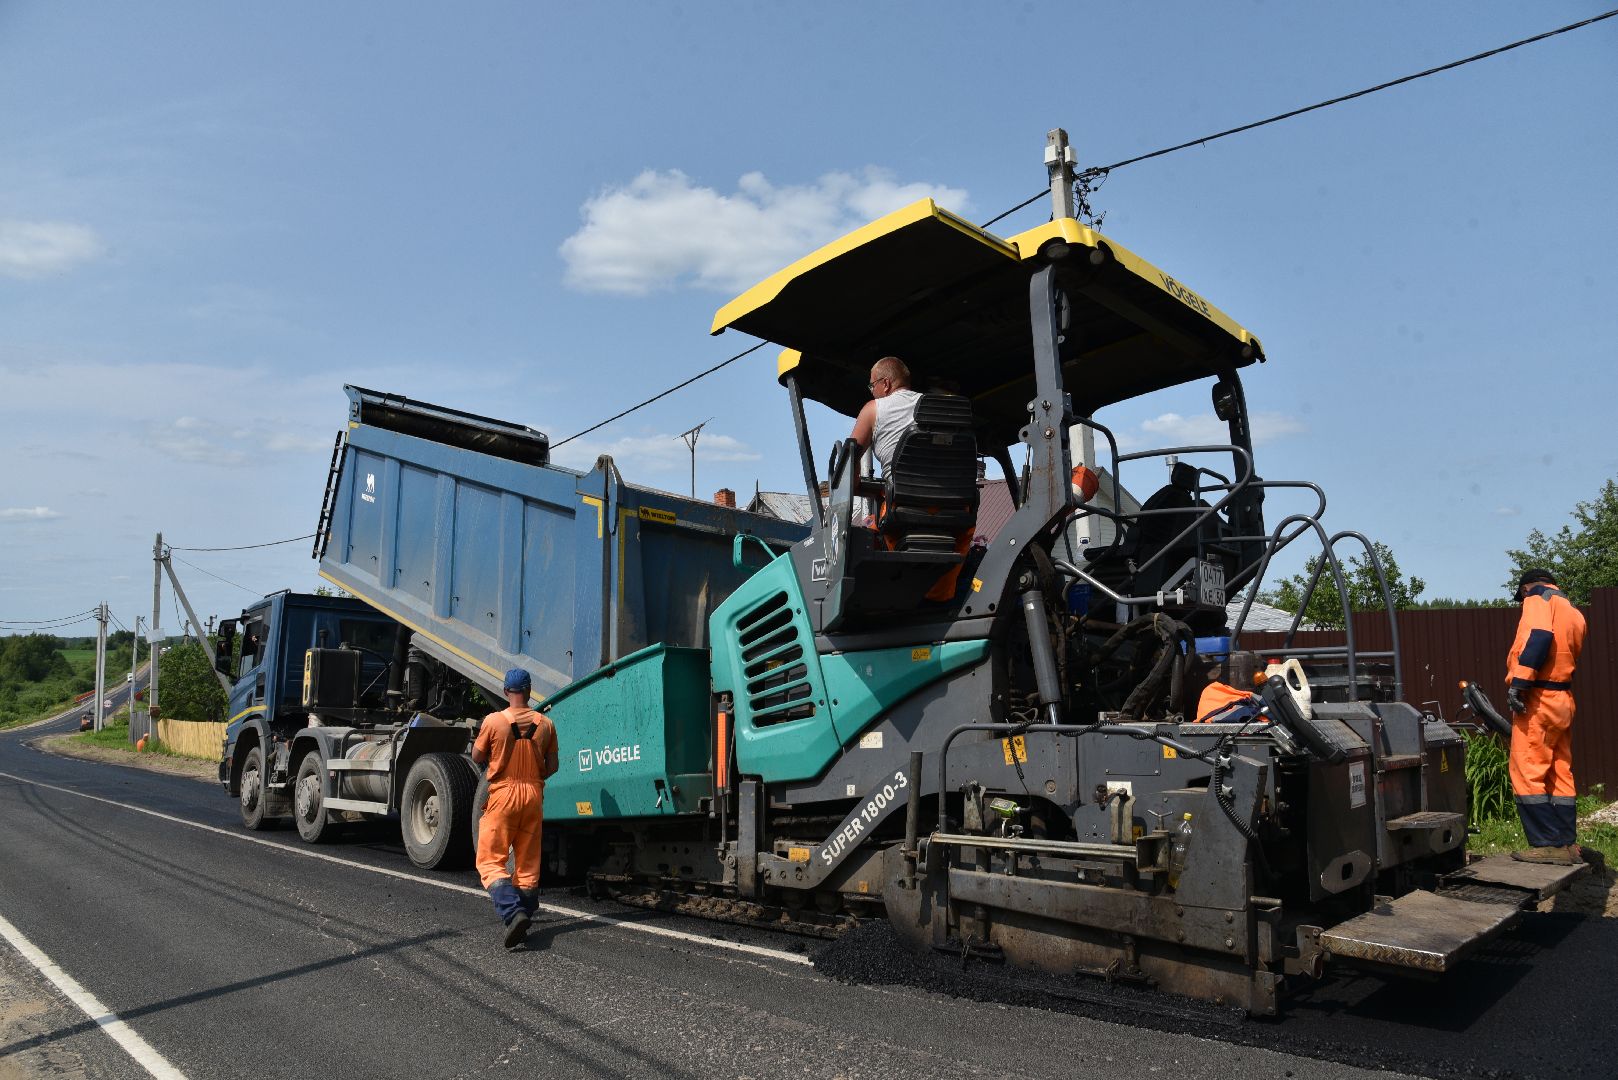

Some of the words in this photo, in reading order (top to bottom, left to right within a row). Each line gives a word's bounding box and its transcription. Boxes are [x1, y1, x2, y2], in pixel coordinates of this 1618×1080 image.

[1158, 272, 1212, 318] VÖGELE
[595, 745, 641, 765] VÖGELE
[821, 817, 865, 866] SUPER
[861, 771, 908, 823] 1800-3
